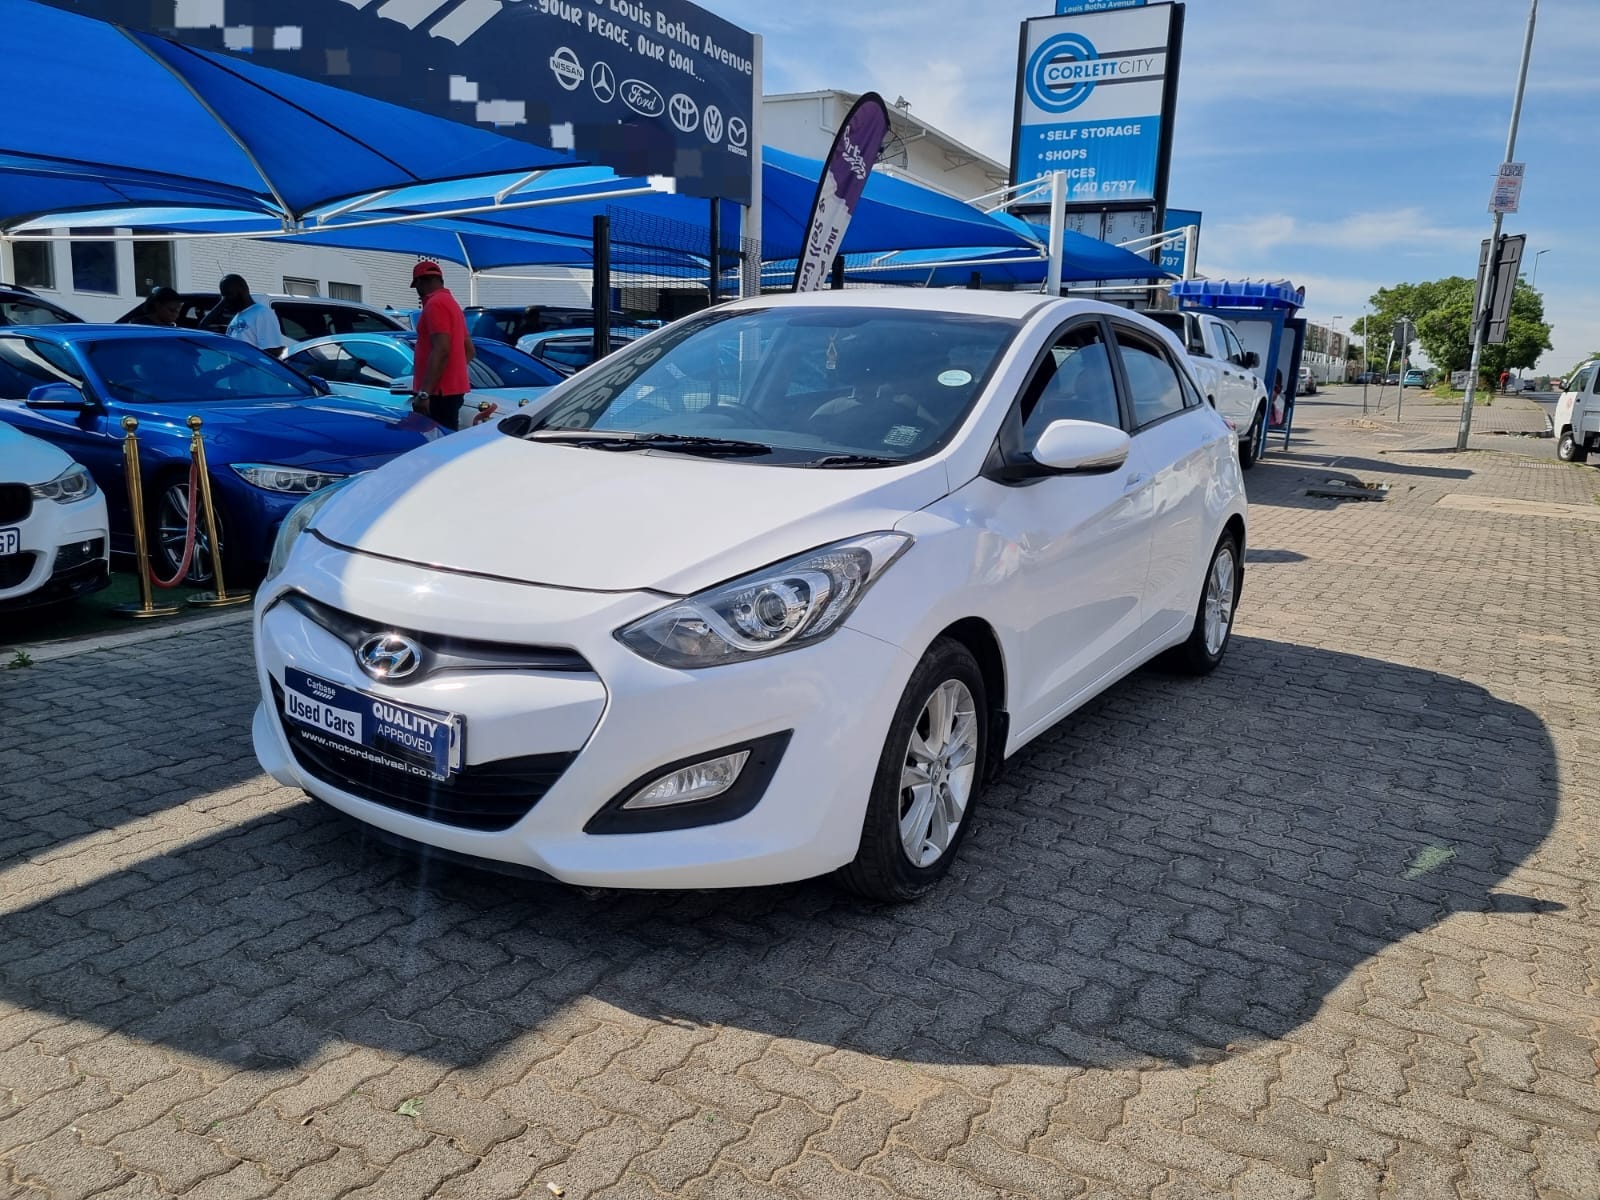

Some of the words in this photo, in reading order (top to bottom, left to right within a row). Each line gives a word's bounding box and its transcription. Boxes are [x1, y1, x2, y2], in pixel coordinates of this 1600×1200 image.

[1084, 3, 1106, 11] Botha
[1106, 0, 1136, 9] Avenue
[609, 0, 652, 28] Louis
[656, 11, 700, 51] Botha
[703, 35, 753, 75] Avenue
[637, 35, 665, 62] OUR
[552, 60, 583, 77] NISSAN
[628, 84, 656, 110] Ford
[1046, 129, 1077, 140] SELF
[1081, 125, 1141, 139] STORAGE
[1045, 149, 1087, 160] SHOPS
[1073, 182, 1098, 193] 440
[1102, 180, 1136, 192] 6797
[306, 678, 336, 696] Carbase
[289, 694, 320, 723] Used
[325, 708, 355, 737] Cars
[372, 702, 438, 738] QUALITY
[377, 723, 433, 753] APPROVED
